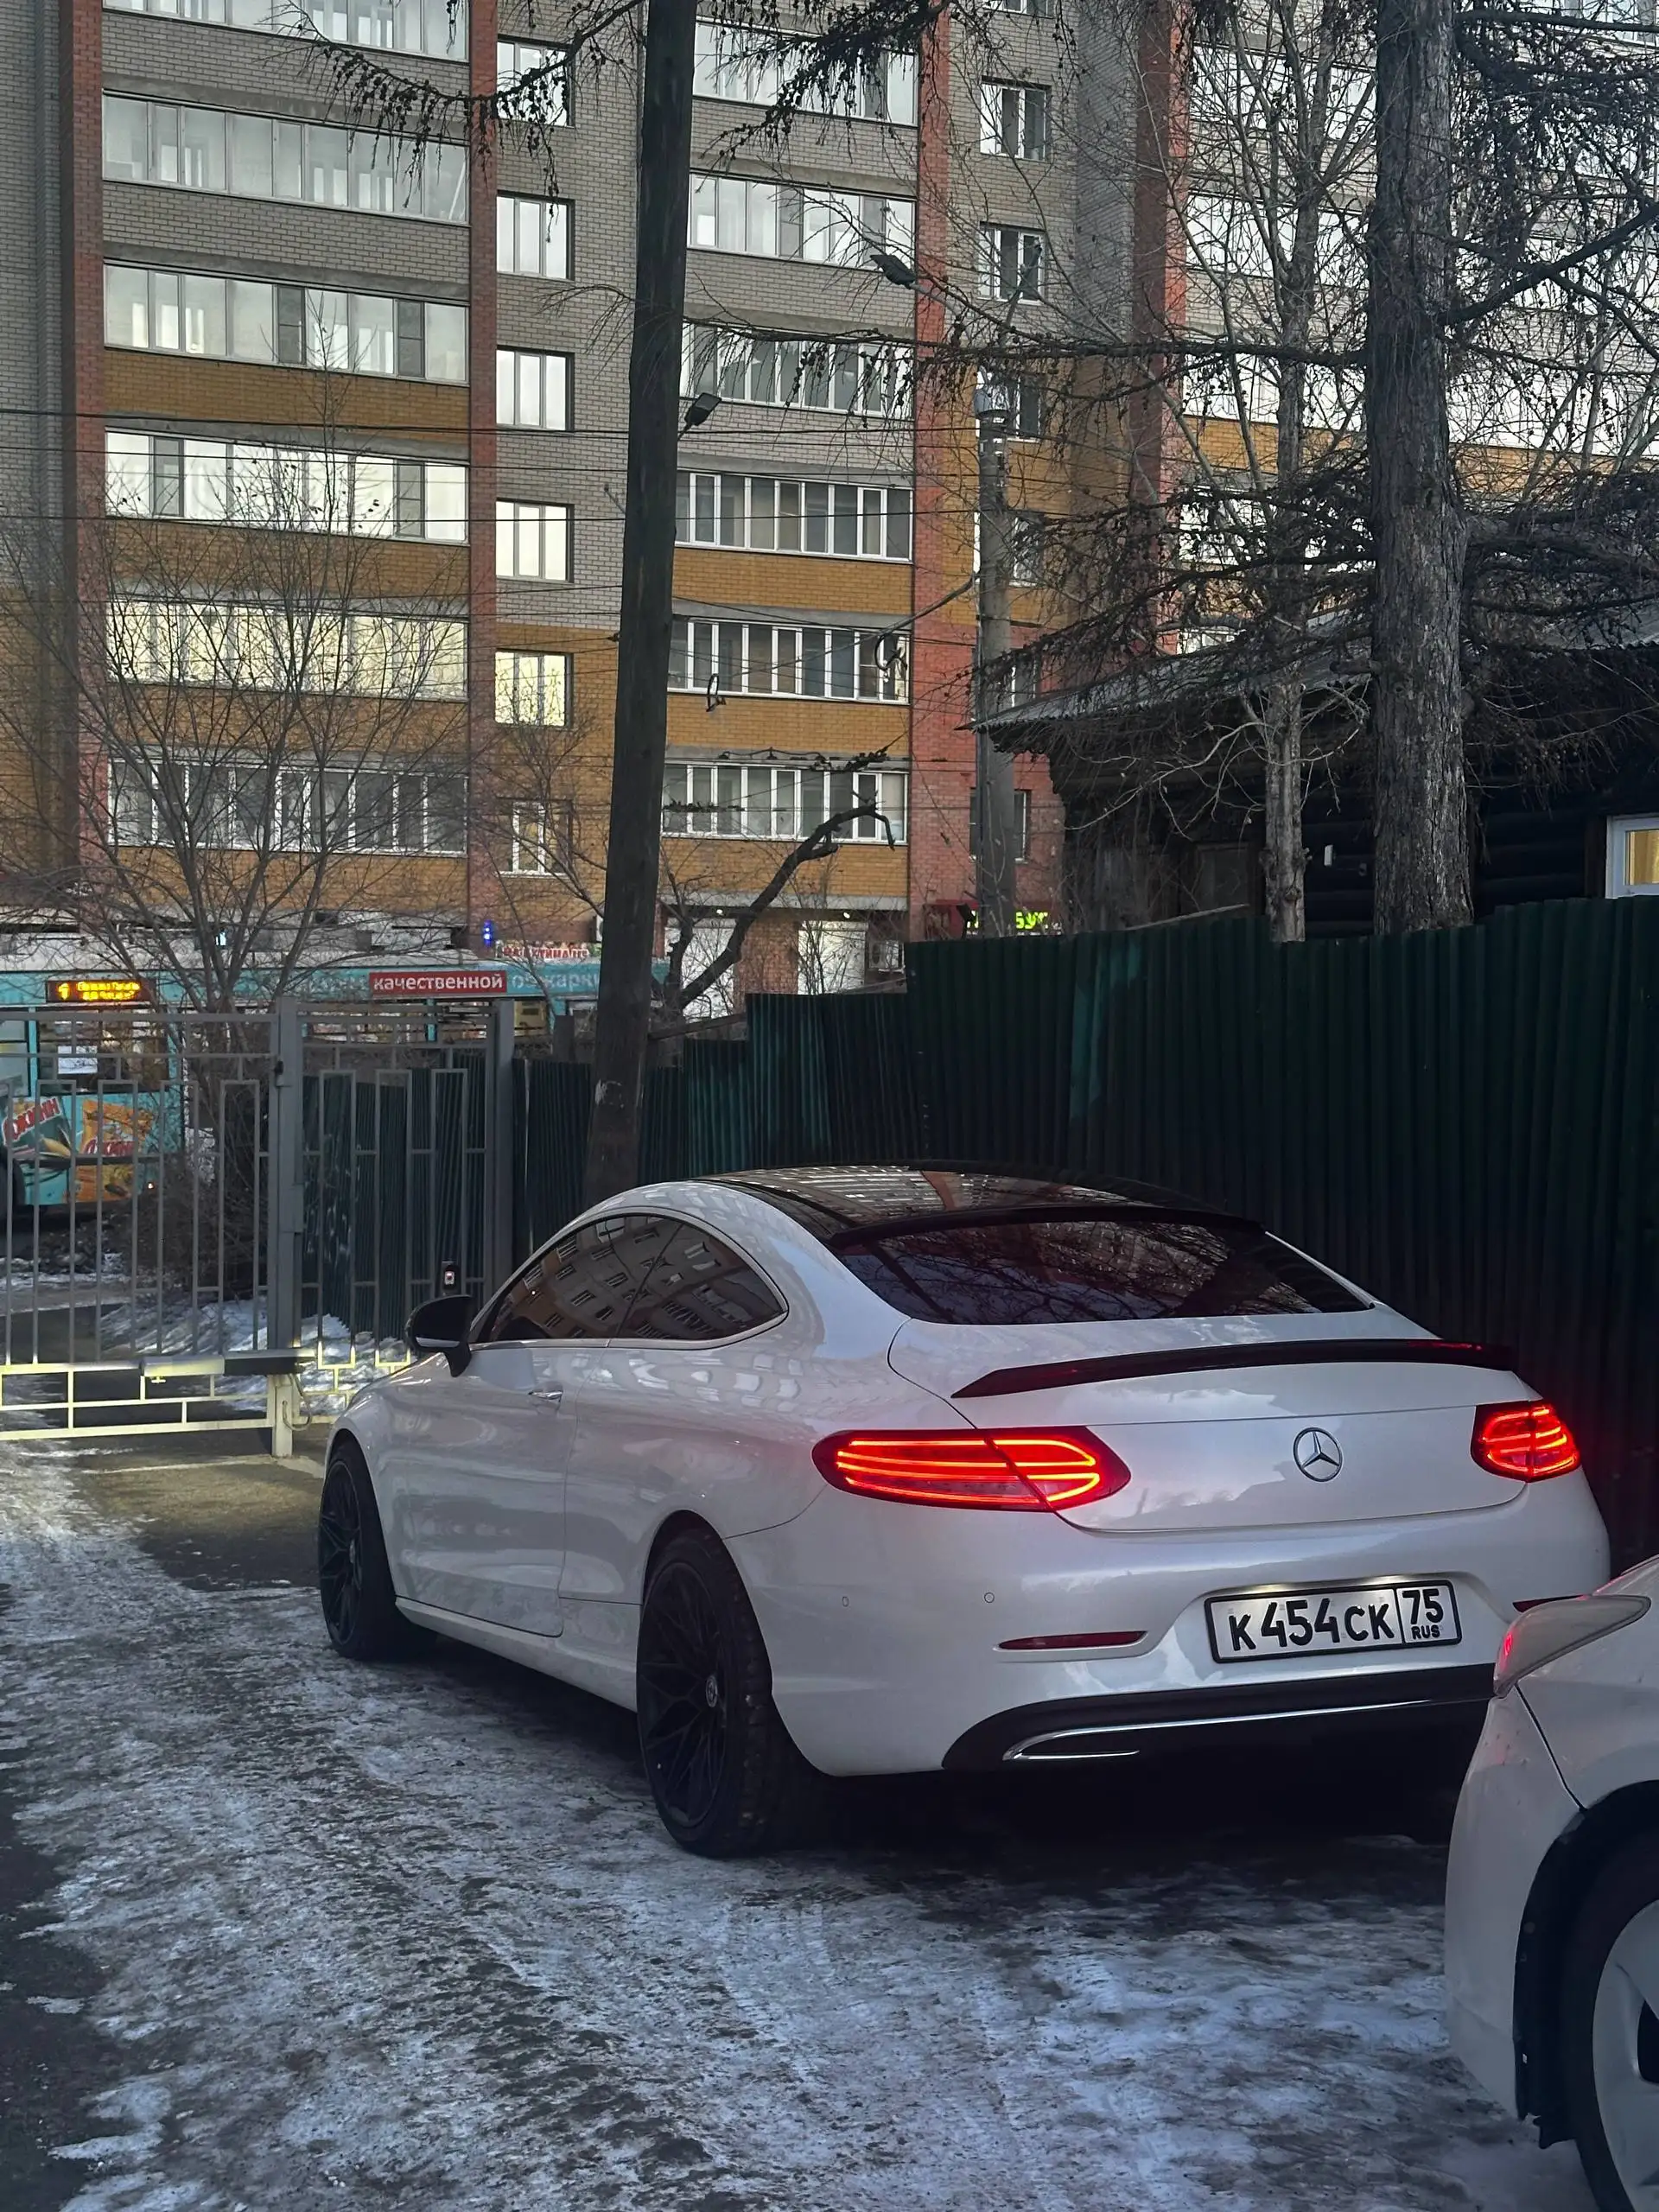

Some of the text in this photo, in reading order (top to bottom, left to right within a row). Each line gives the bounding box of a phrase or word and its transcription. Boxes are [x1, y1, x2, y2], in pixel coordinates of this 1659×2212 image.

[373, 974, 503, 991] качественной
[1402, 1588, 1445, 1625] 75
[1412, 1624, 1441, 1640] RUS
